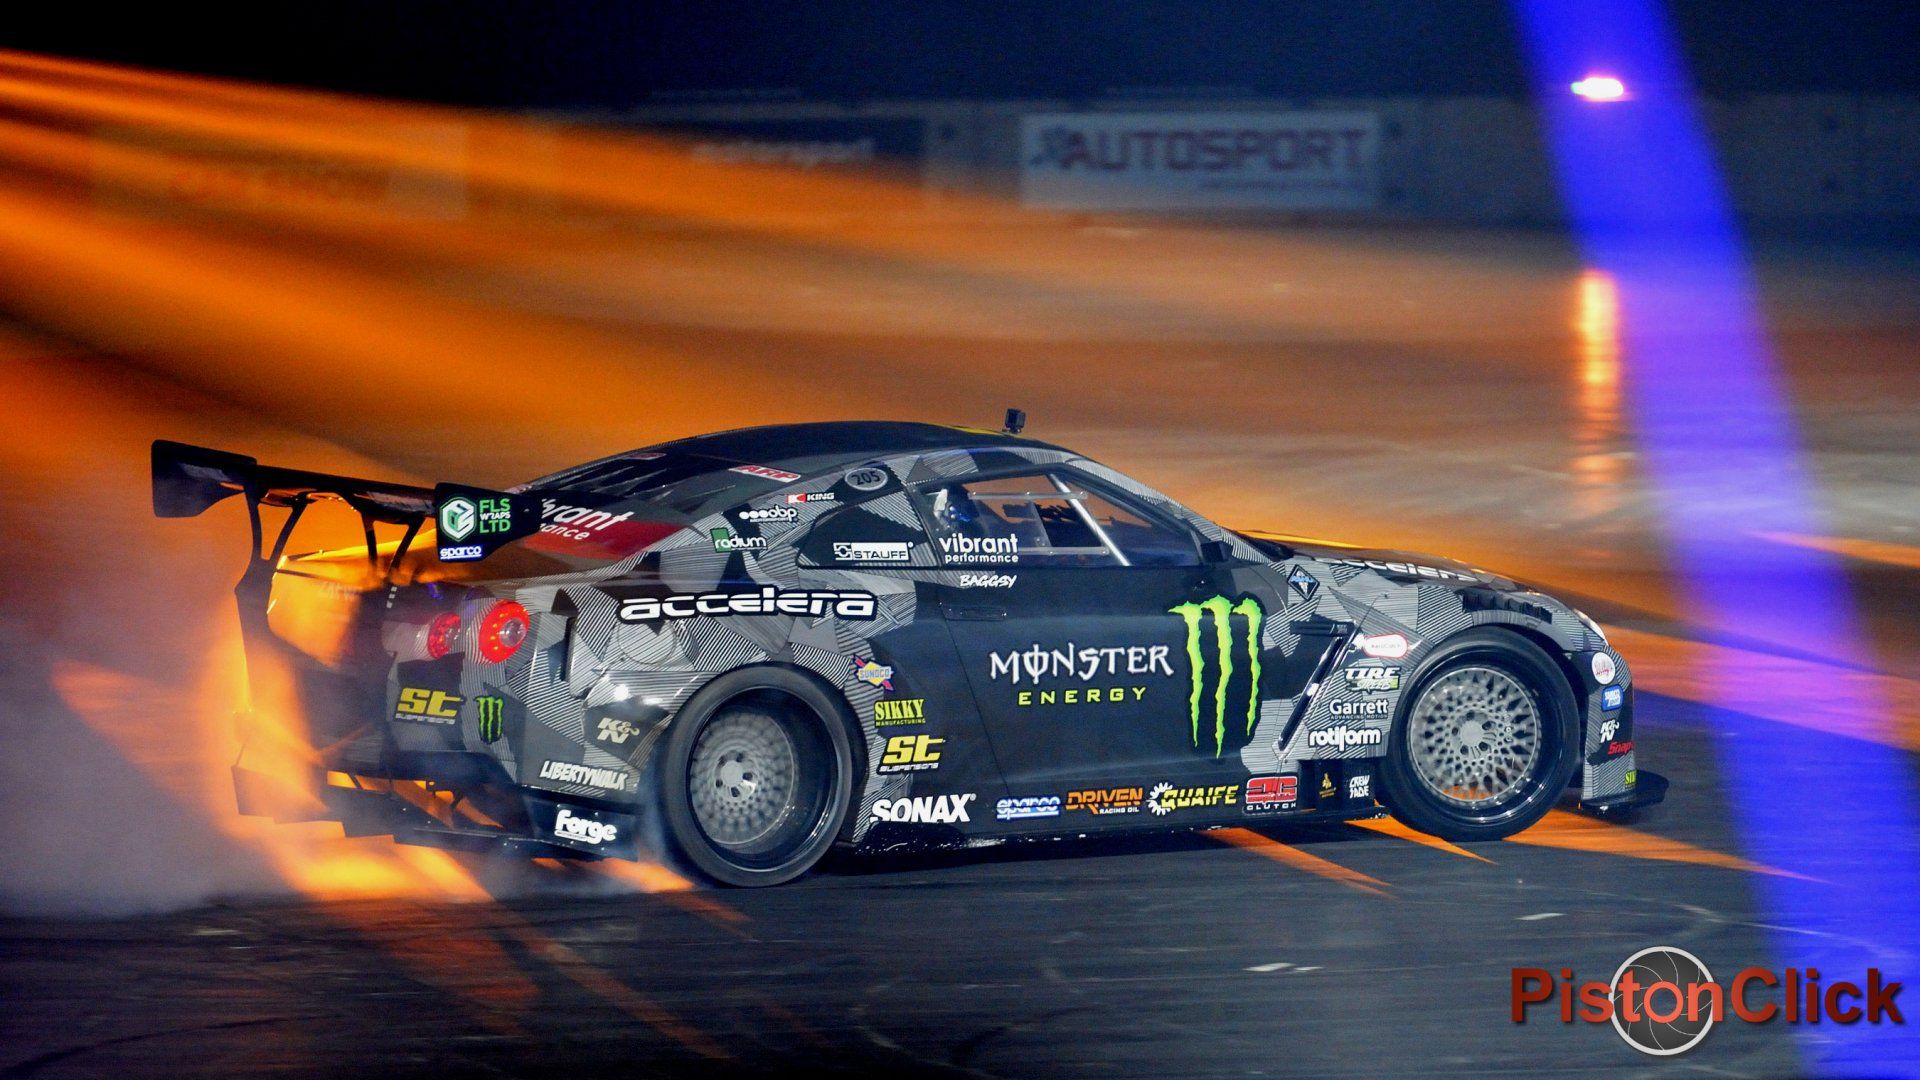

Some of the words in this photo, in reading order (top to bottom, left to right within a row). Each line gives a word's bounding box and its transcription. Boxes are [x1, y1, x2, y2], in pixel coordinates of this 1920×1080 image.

[851, 470, 880, 486] 205
[806, 492, 834, 501] KING
[480, 498, 511, 512] FLS
[480, 520, 511, 533] LTD
[715, 535, 767, 549] radium
[939, 532, 1018, 554] vibrant
[440, 546, 482, 559] sparco
[853, 551, 907, 559] STAUFF
[945, 553, 1019, 564] performance
[960, 574, 1018, 588] BAGGSY
[620, 587, 874, 620] accelera
[990, 642, 1174, 685] MONSTER
[859, 668, 890, 680] SUNOCO
[1018, 687, 1147, 706] ENERGY
[875, 699, 925, 721] SIKKY
[1329, 699, 1389, 716] Garrett
[1309, 726, 1381, 752] rotiform
[1066, 787, 1143, 814] DRIVEN
[1161, 785, 1239, 810] QUAIFE
[997, 797, 1061, 820] sparco
[1246, 802, 1297, 811] CLUTCH
[555, 809, 618, 844] Forge
